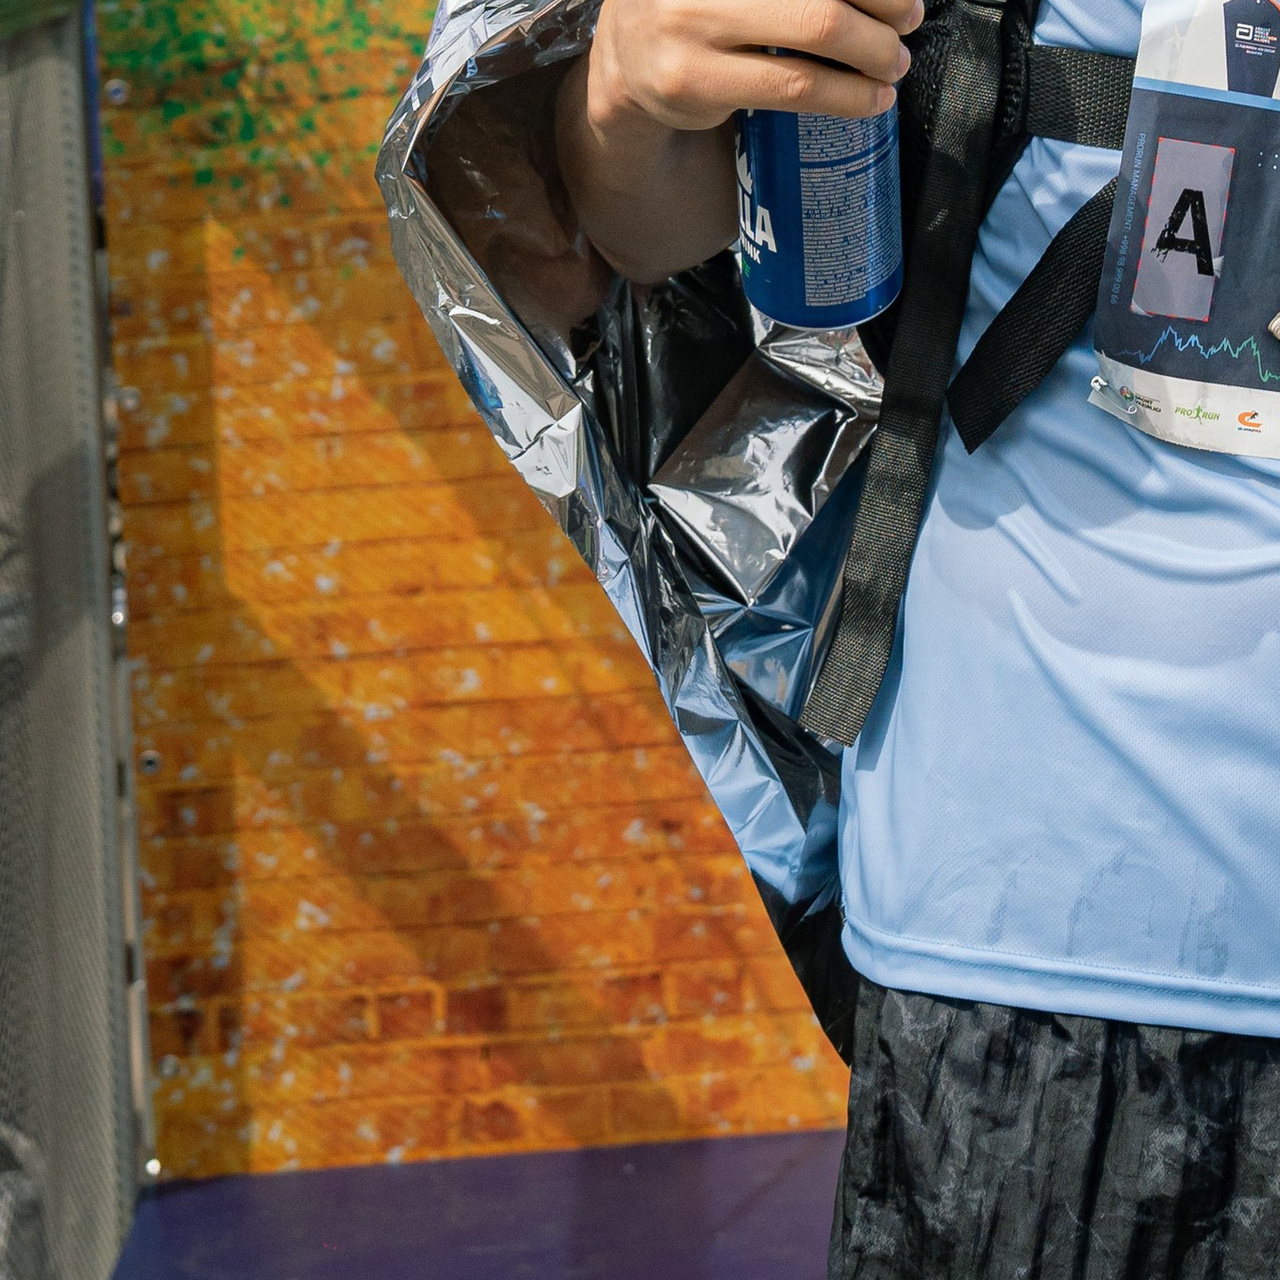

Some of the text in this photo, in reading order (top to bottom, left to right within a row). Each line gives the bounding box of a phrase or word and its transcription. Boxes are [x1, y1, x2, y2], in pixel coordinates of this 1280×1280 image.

[1132, 133, 1146, 169] PRORUN
[1150, 188, 1214, 276] A
[1174, 406, 1220, 421] PRO RUN
